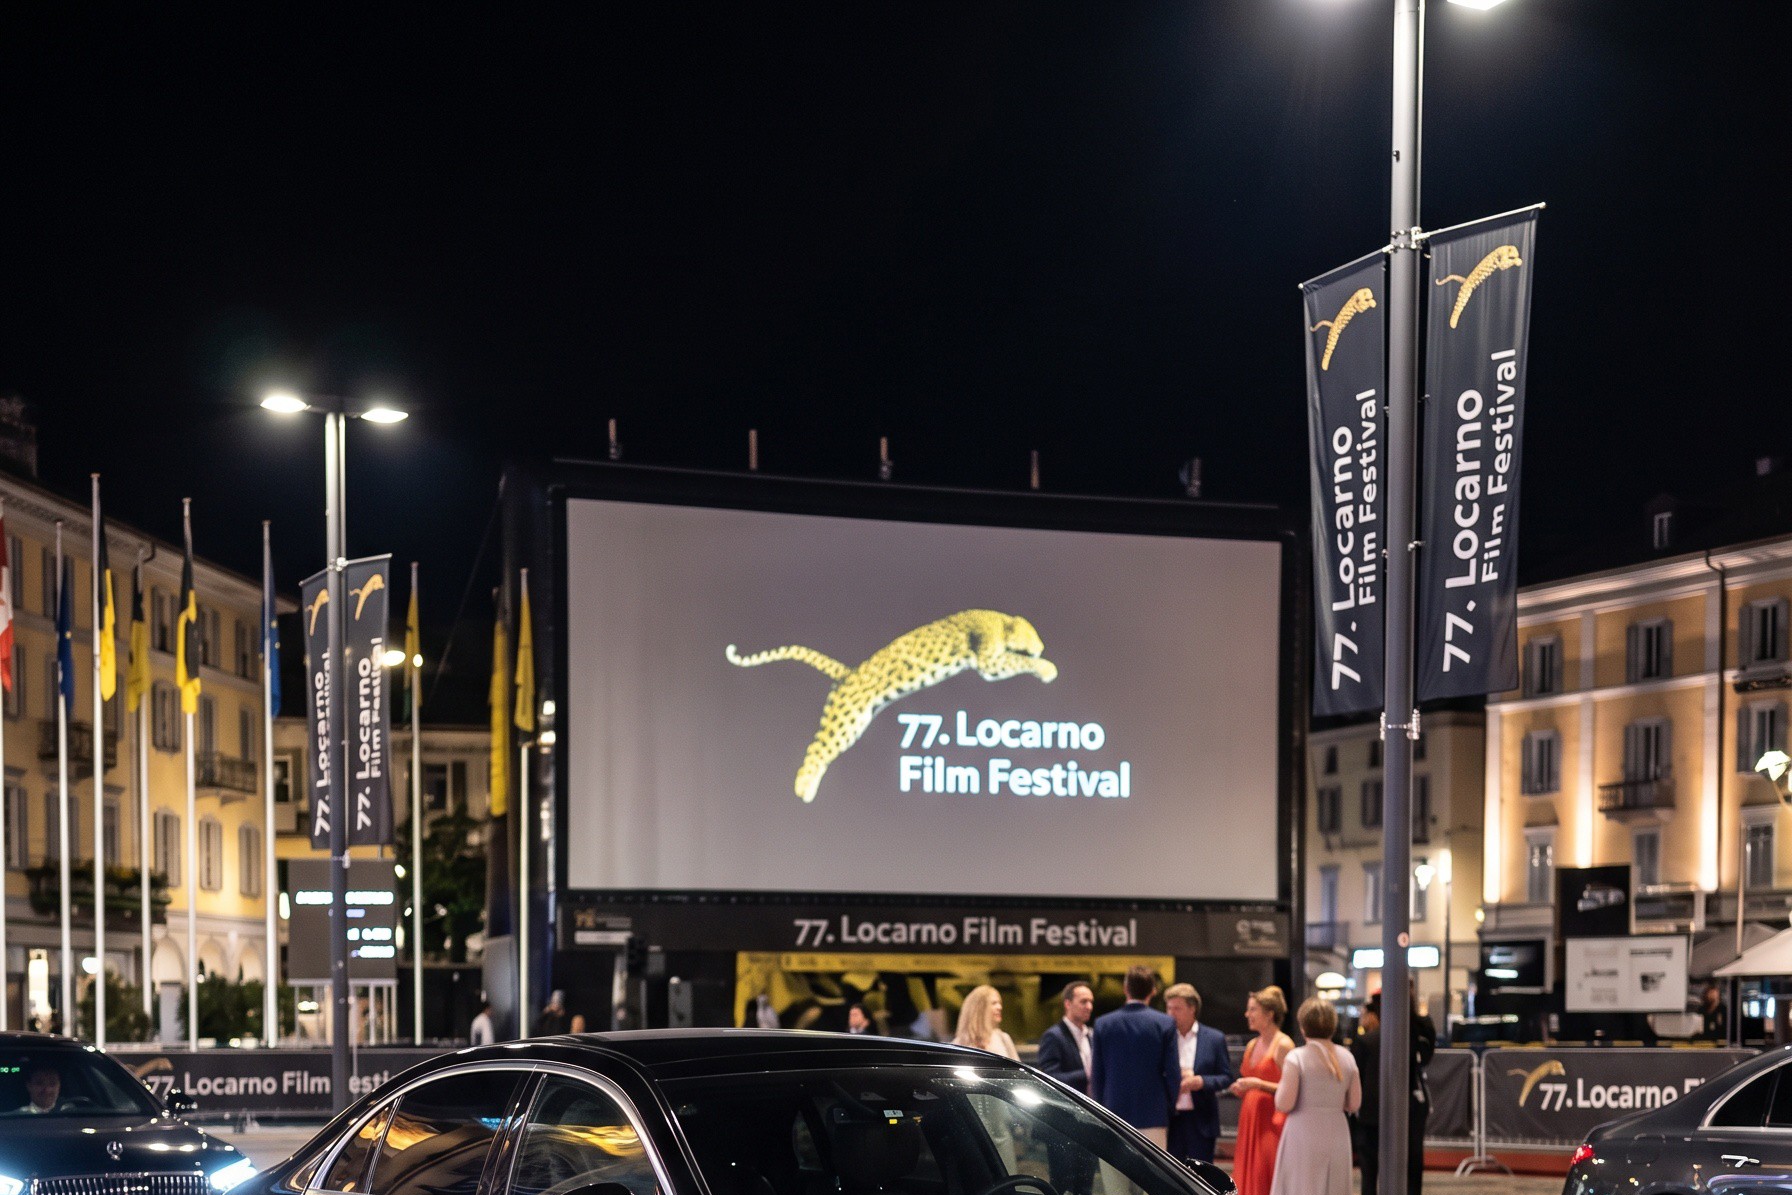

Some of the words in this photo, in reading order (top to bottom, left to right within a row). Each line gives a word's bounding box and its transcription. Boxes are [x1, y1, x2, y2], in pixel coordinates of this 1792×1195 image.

[1355, 388, 1377, 524] Festival
[1487, 348, 1517, 495] Festival
[1331, 426, 1357, 612] Locarno
[1444, 388, 1484, 589] Locarno
[1357, 531, 1377, 606] Film
[1481, 503, 1505, 583] Film
[1331, 621, 1361, 691] 77.
[1442, 600, 1477, 672] 77.
[314, 670, 329, 788] Locarno
[355, 657, 372, 780] Locarno
[370, 728, 382, 778] Film
[897, 714, 950, 749] 77.
[956, 710, 1105, 751] Locarno
[356, 786, 372, 831] 77.
[900, 755, 980, 794] Film
[988, 758, 1131, 798] Festival
[314, 795, 331, 837] 77.
[793, 919, 835, 947] 77.
[841, 915, 957, 944] Locarno
[963, 917, 1023, 944] Film
[1030, 918, 1137, 947] Festival
[184, 1072, 278, 1096] Locarno
[282, 1070, 331, 1094] Film
[1539, 1083, 1573, 1112] 77.
[1577, 1077, 1678, 1109] Locarno
